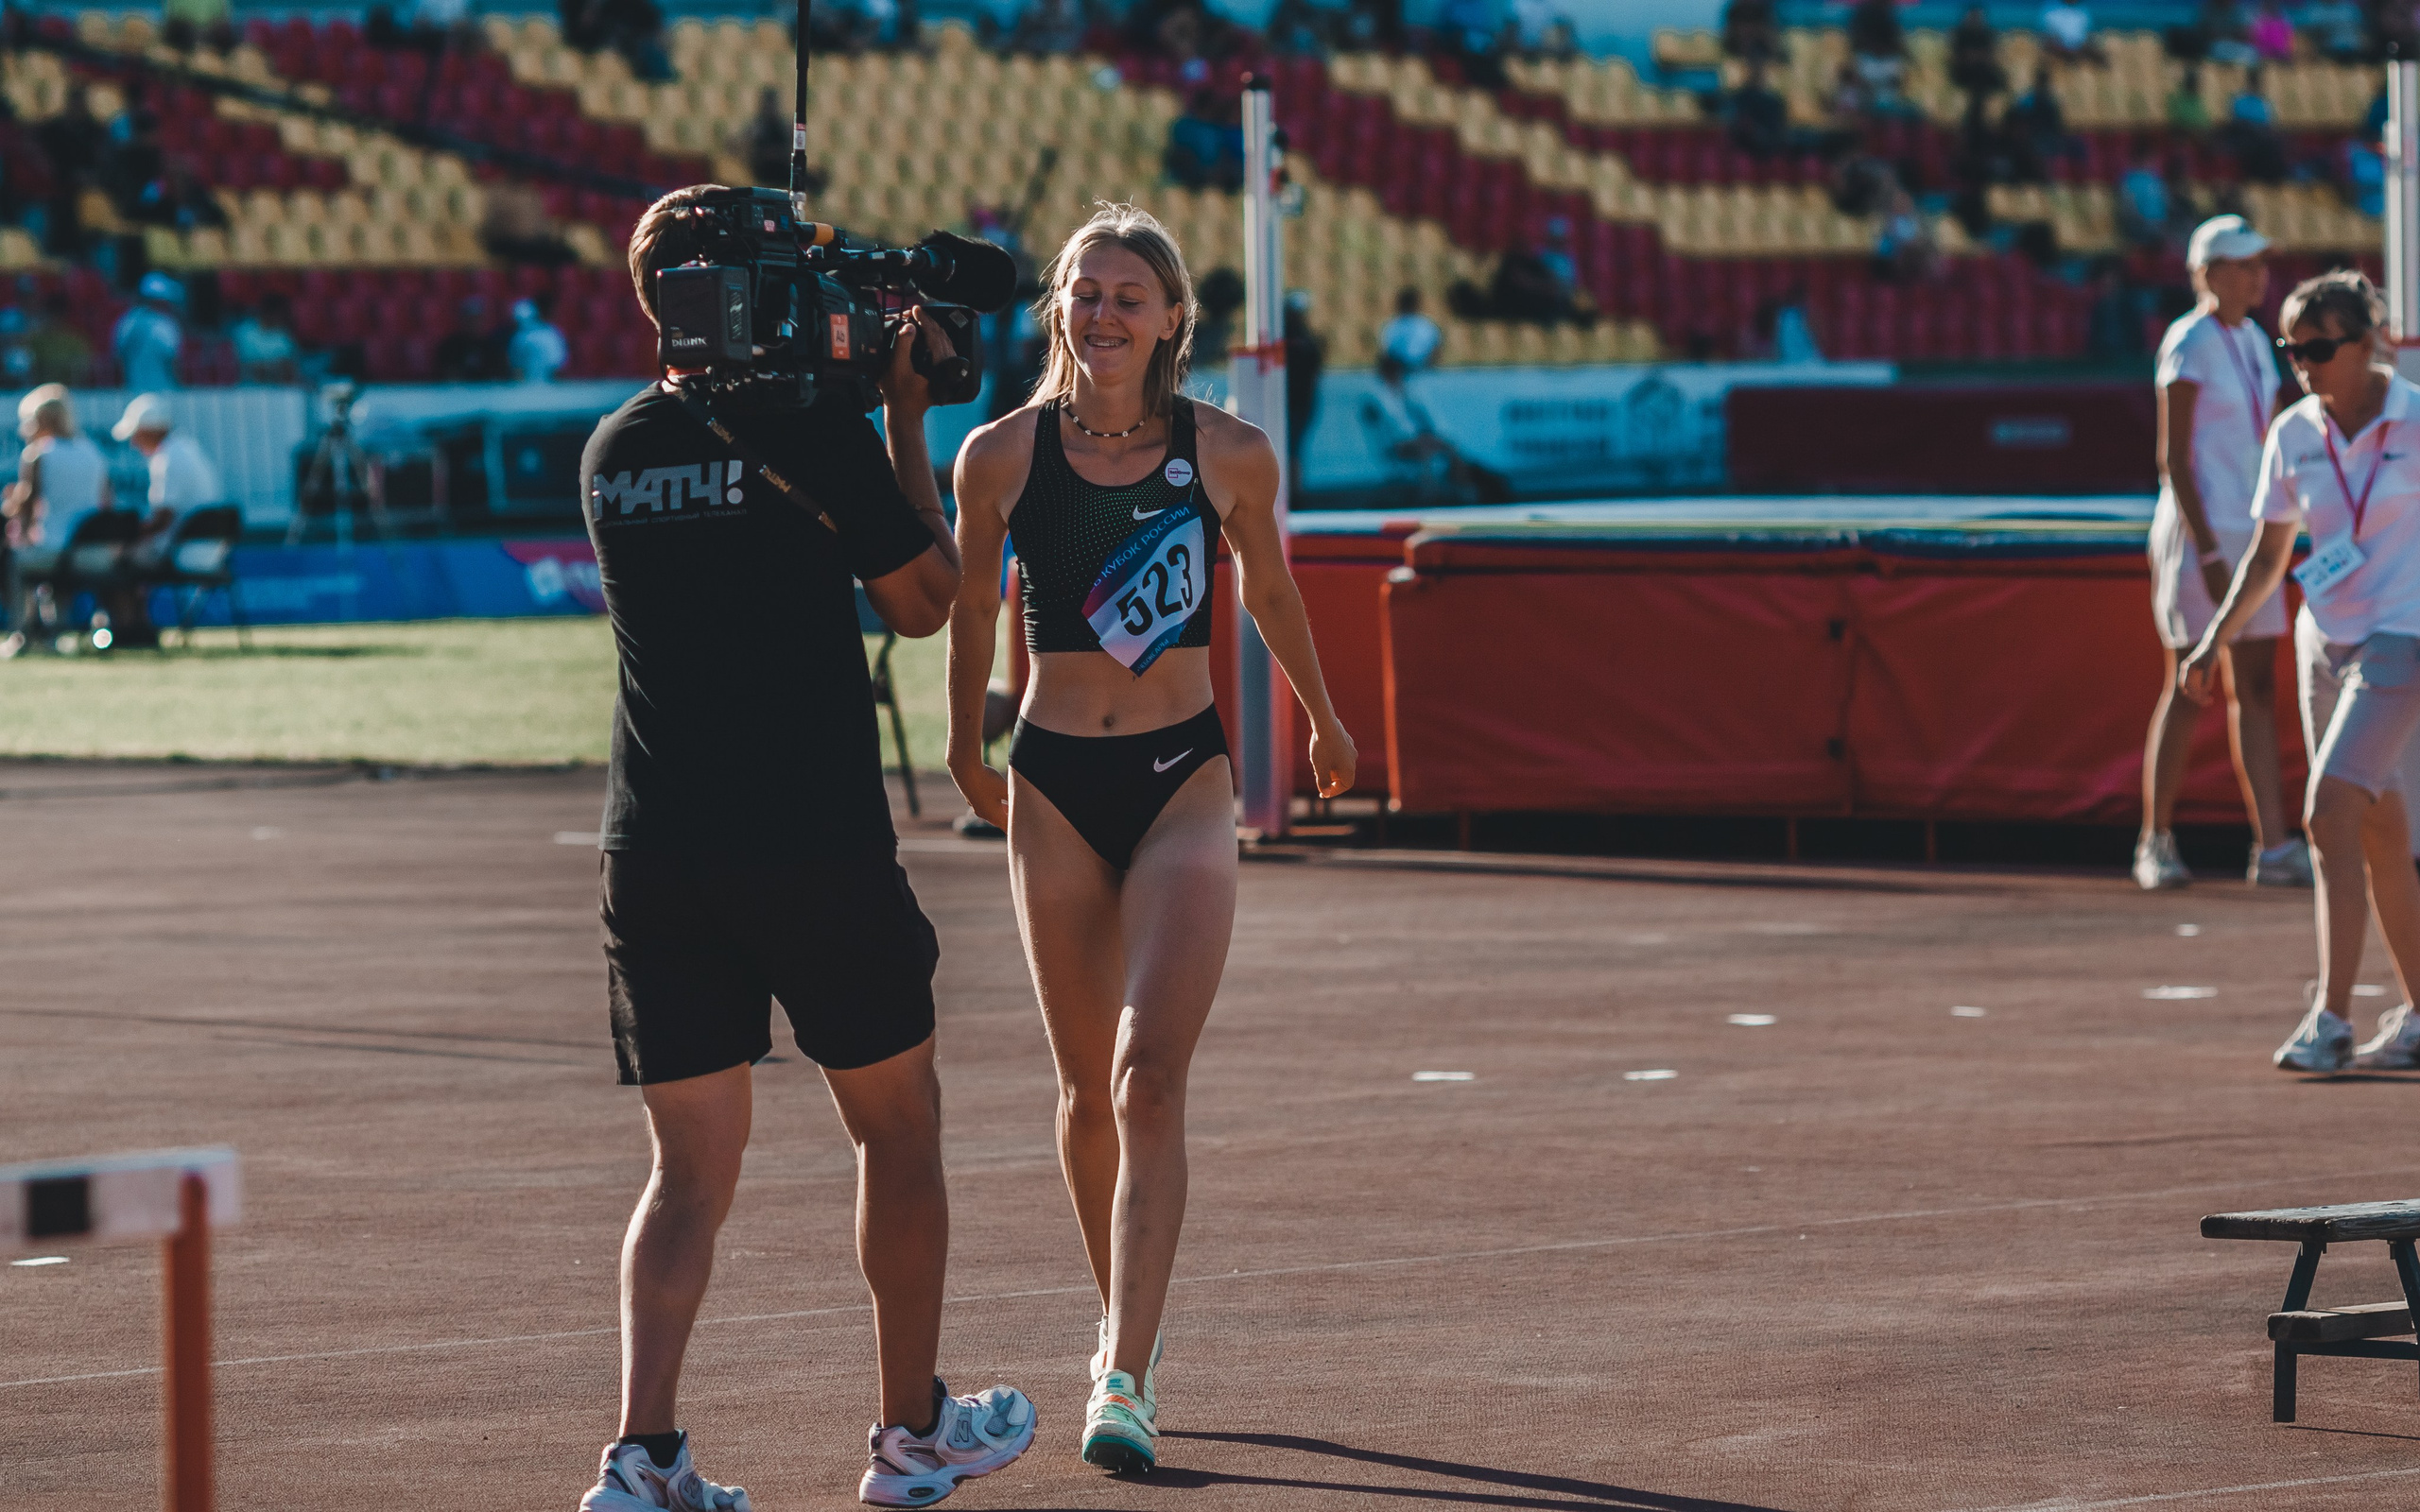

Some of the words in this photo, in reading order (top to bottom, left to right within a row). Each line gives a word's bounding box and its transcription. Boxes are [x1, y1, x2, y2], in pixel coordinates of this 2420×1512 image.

[1101, 544, 1142, 578] КУБОК
[1141, 507, 1189, 546] РОССИИ
[1115, 543, 1193, 636] 523
